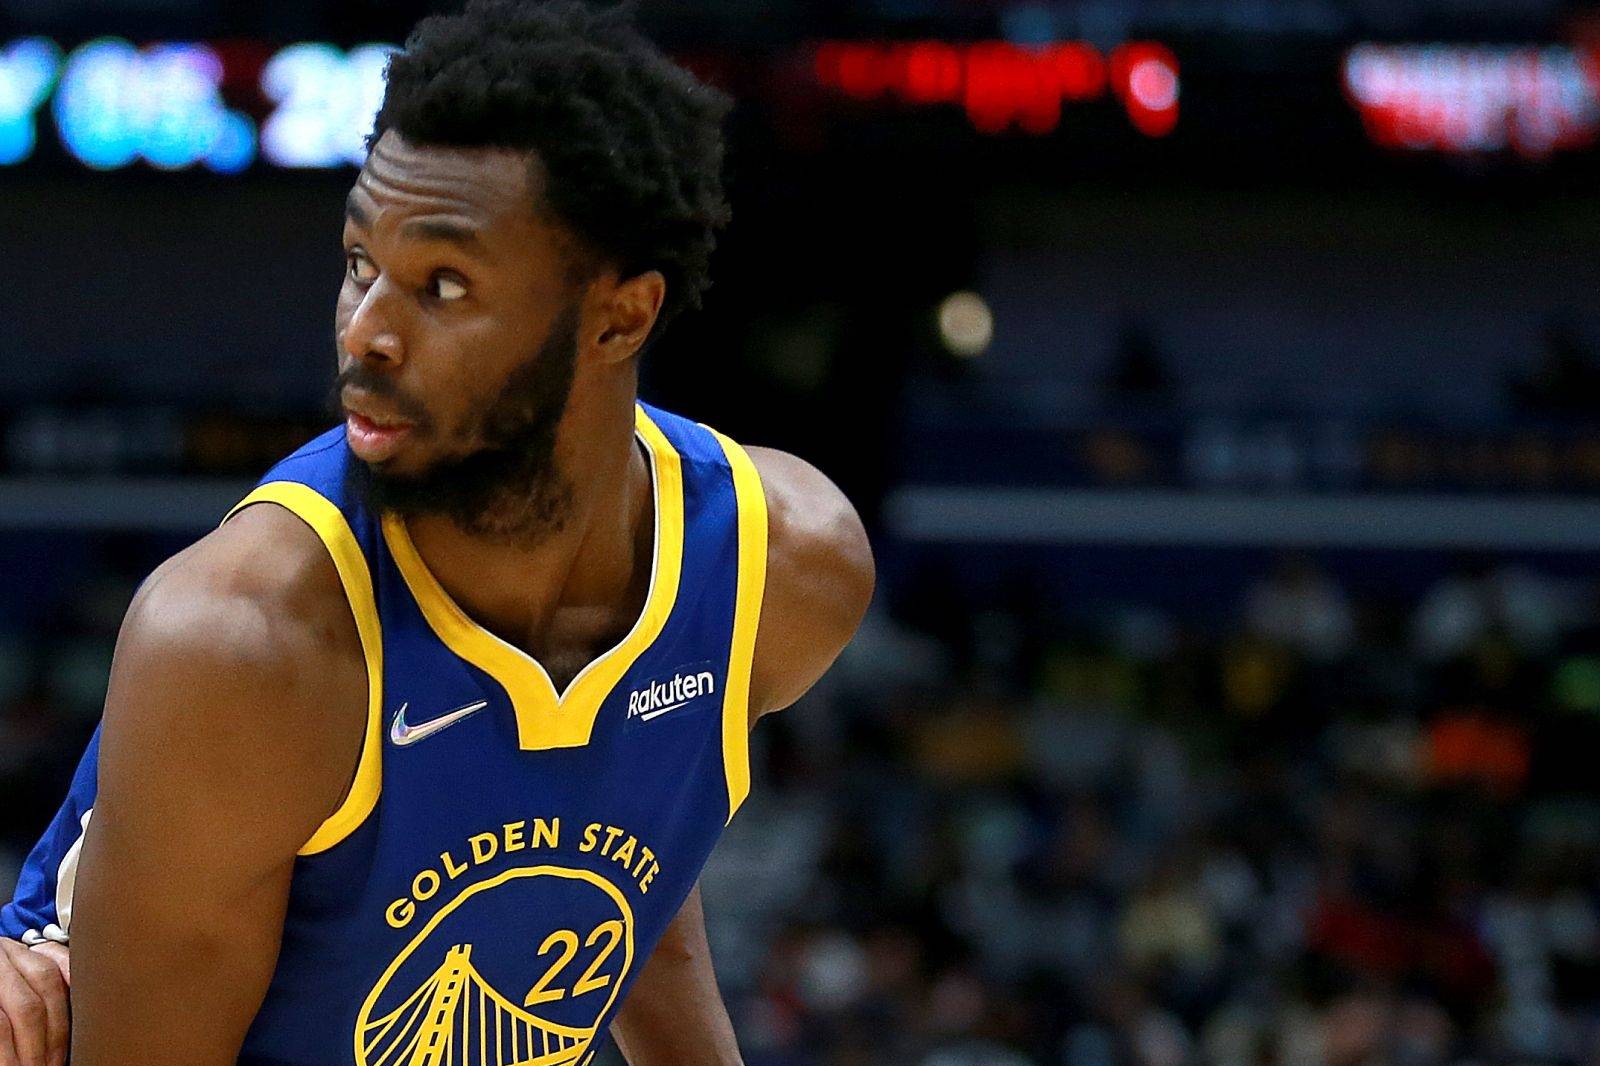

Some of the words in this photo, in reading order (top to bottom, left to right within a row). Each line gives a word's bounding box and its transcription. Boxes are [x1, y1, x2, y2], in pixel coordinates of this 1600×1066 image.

[627, 671, 714, 719] Rakuten
[385, 817, 560, 928] GOLDEN
[579, 822, 660, 895] STATE
[523, 919, 624, 1007] 22
